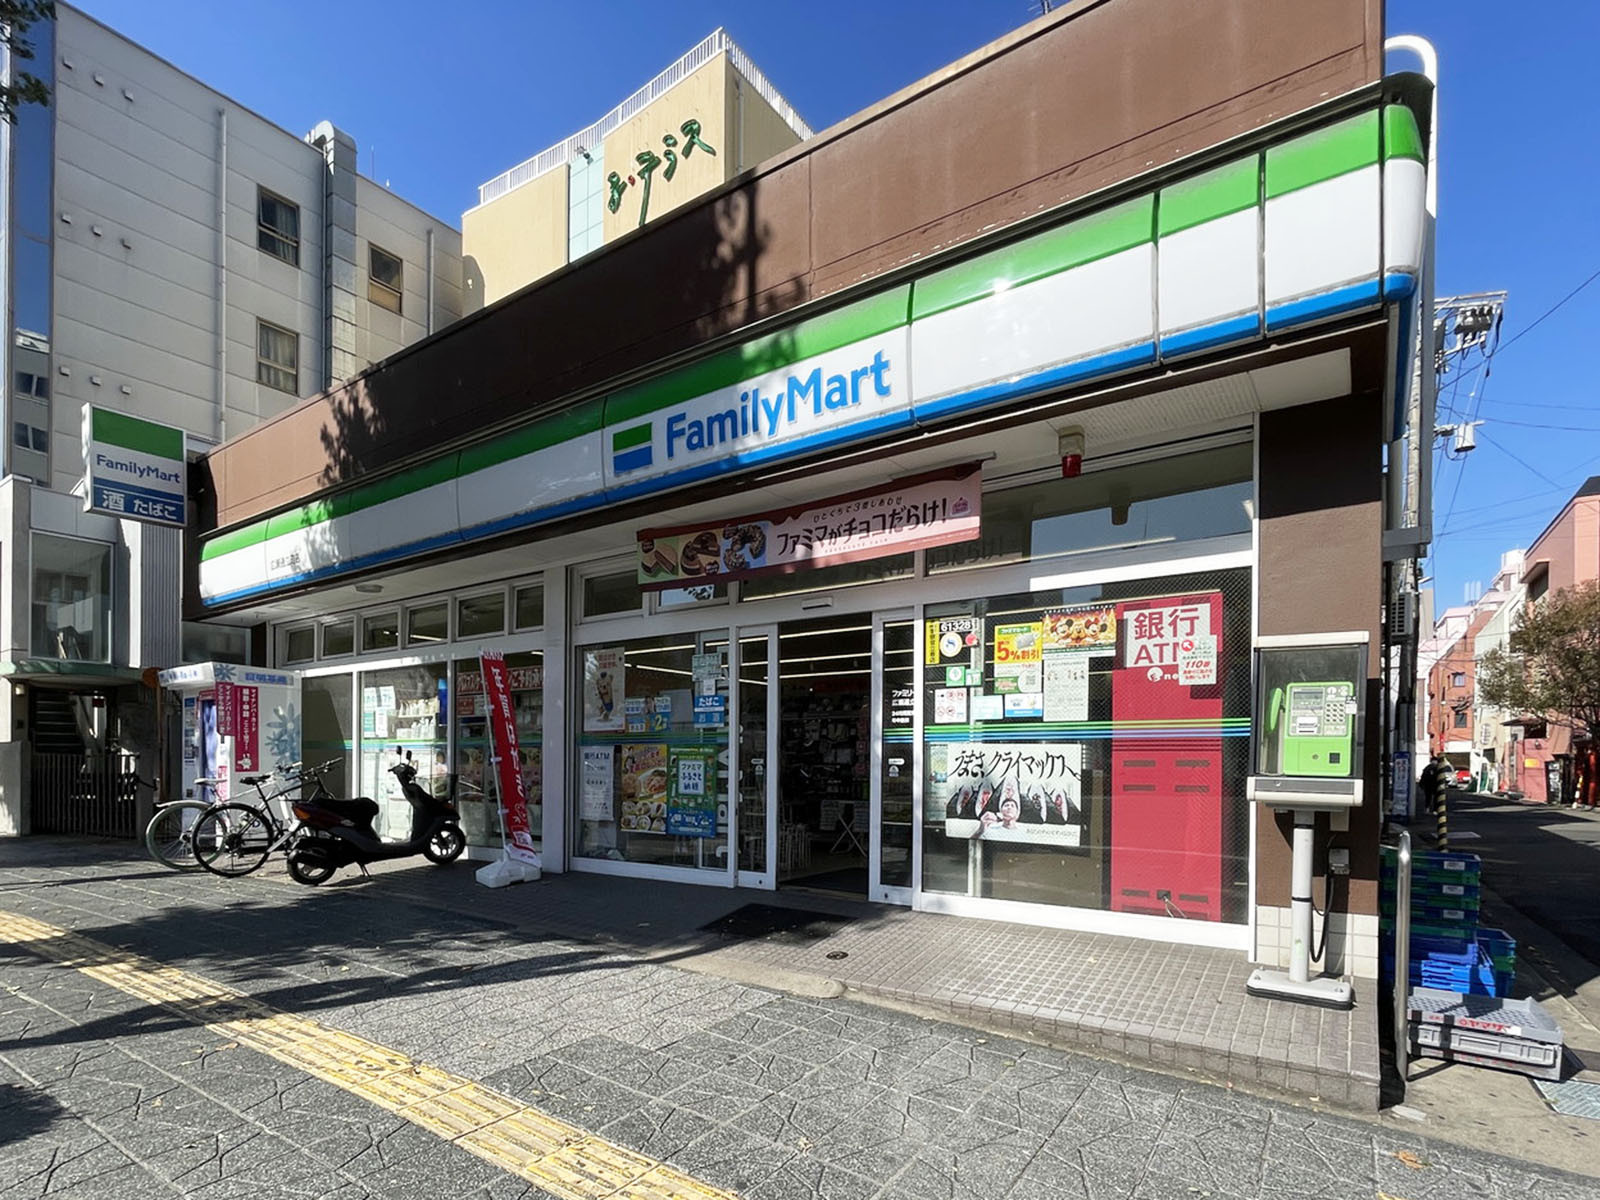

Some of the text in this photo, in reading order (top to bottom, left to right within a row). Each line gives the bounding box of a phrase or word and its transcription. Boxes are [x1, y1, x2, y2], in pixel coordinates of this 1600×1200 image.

[666, 350, 893, 460] FamilyMart
[96, 453, 180, 484] FamilyMart
[102, 489, 177, 520] 酒 たばこ
[1134, 608, 1200, 640] 銀行
